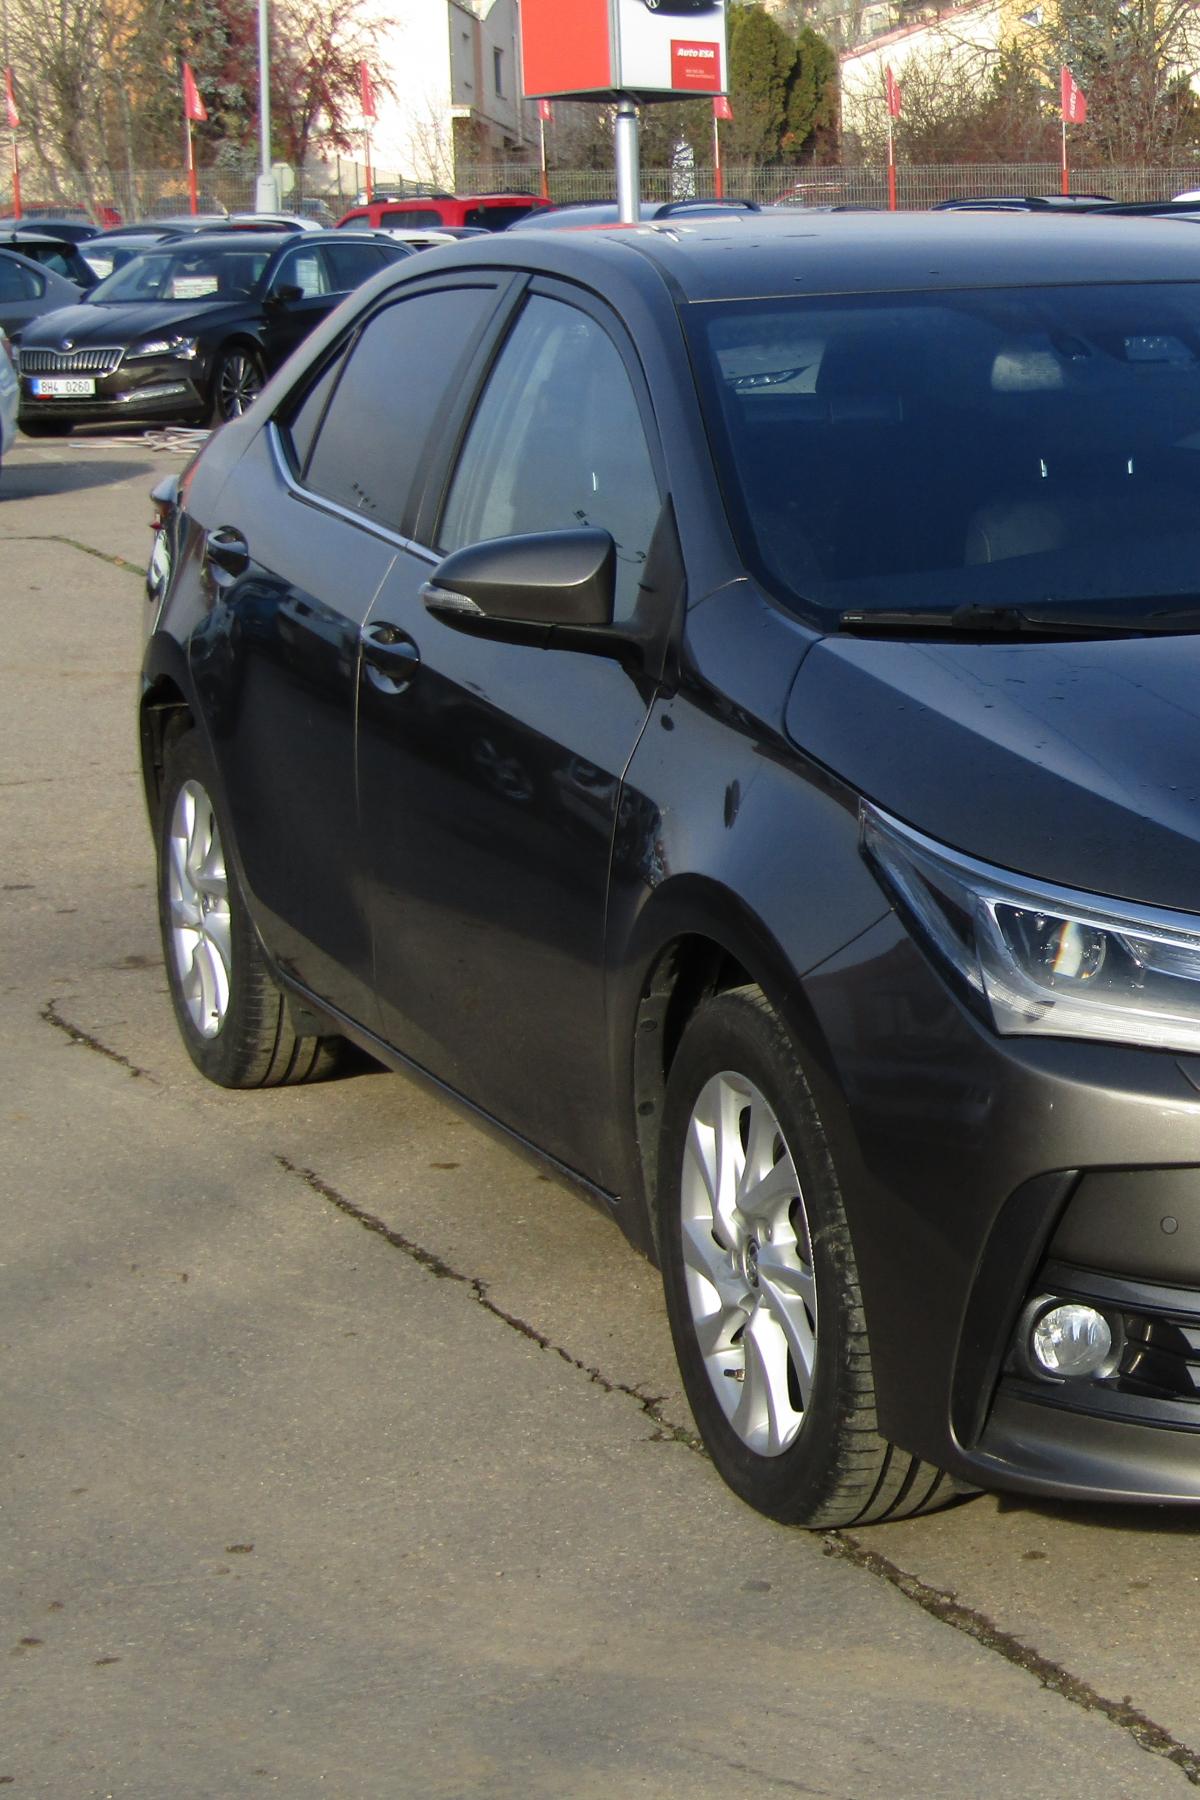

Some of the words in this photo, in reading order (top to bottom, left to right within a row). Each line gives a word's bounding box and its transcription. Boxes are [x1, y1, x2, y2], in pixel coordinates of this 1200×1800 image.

[677, 48, 698, 57] Auto
[699, 50, 715, 59] ESA
[65, 381, 90, 392] 0260
